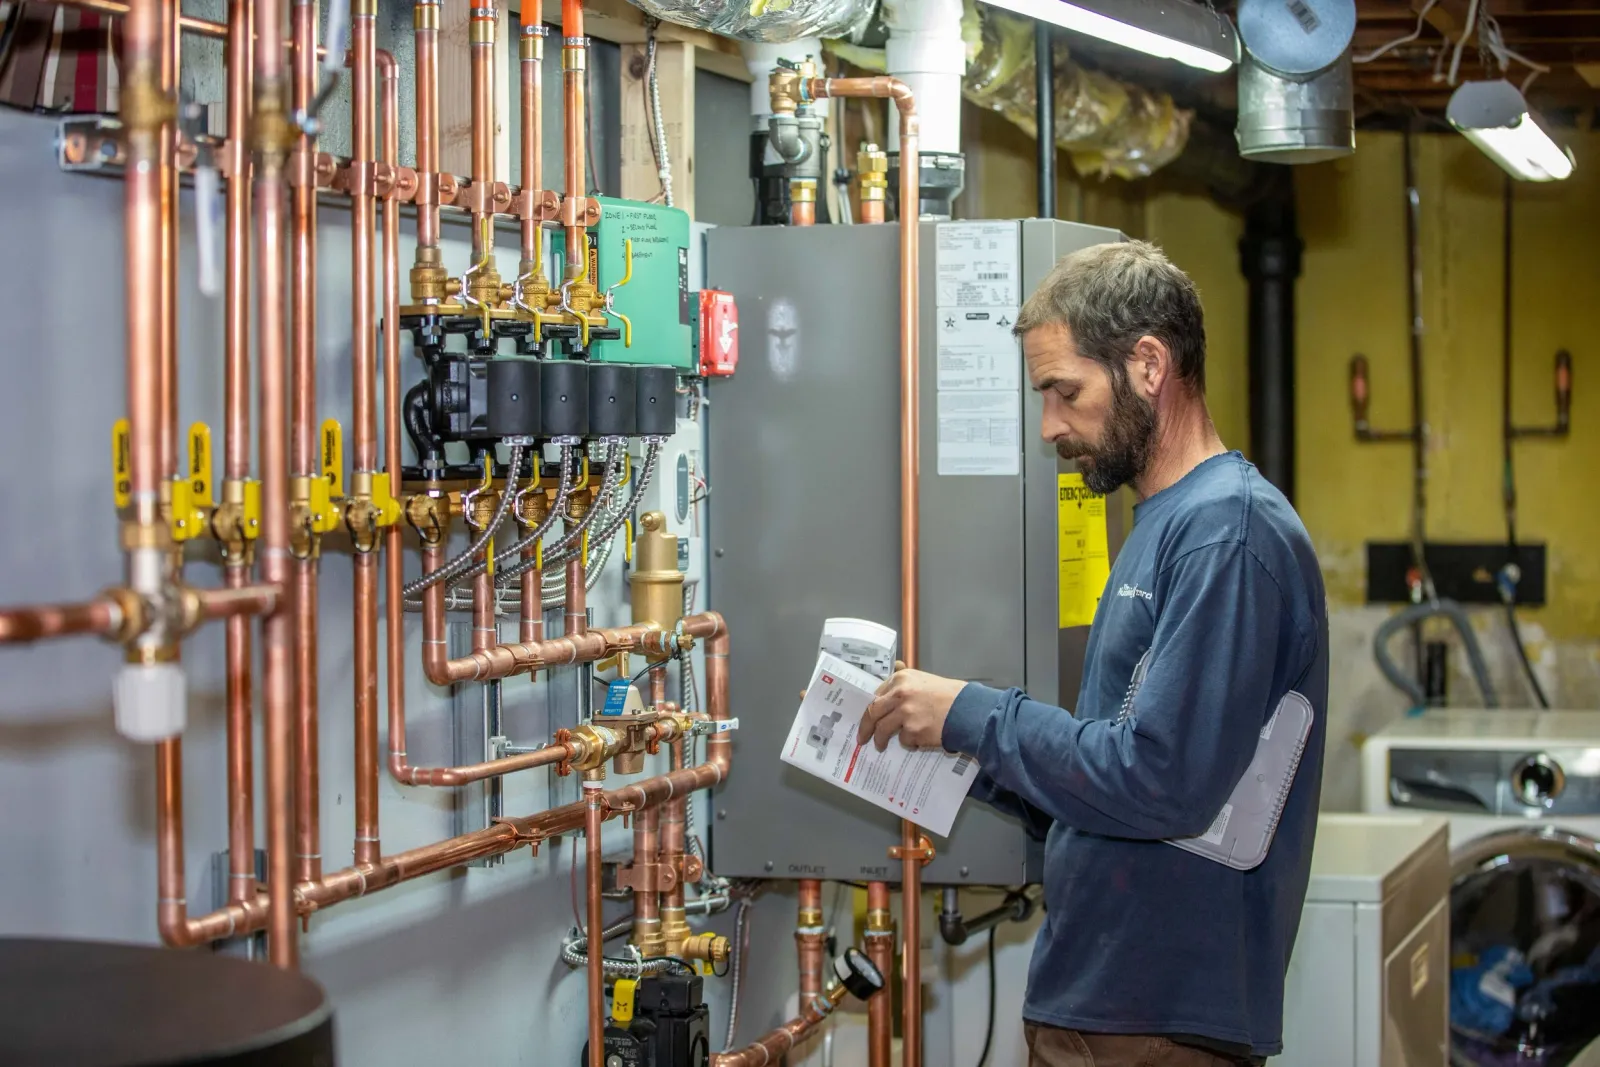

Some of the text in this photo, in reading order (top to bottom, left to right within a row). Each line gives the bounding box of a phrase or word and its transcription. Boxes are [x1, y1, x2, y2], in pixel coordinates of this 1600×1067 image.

[604, 211, 621, 220] ZONE
[629, 212, 643, 220] FIRST
[788, 864, 825, 874] OUTLET
[860, 866, 888, 876] INLET
